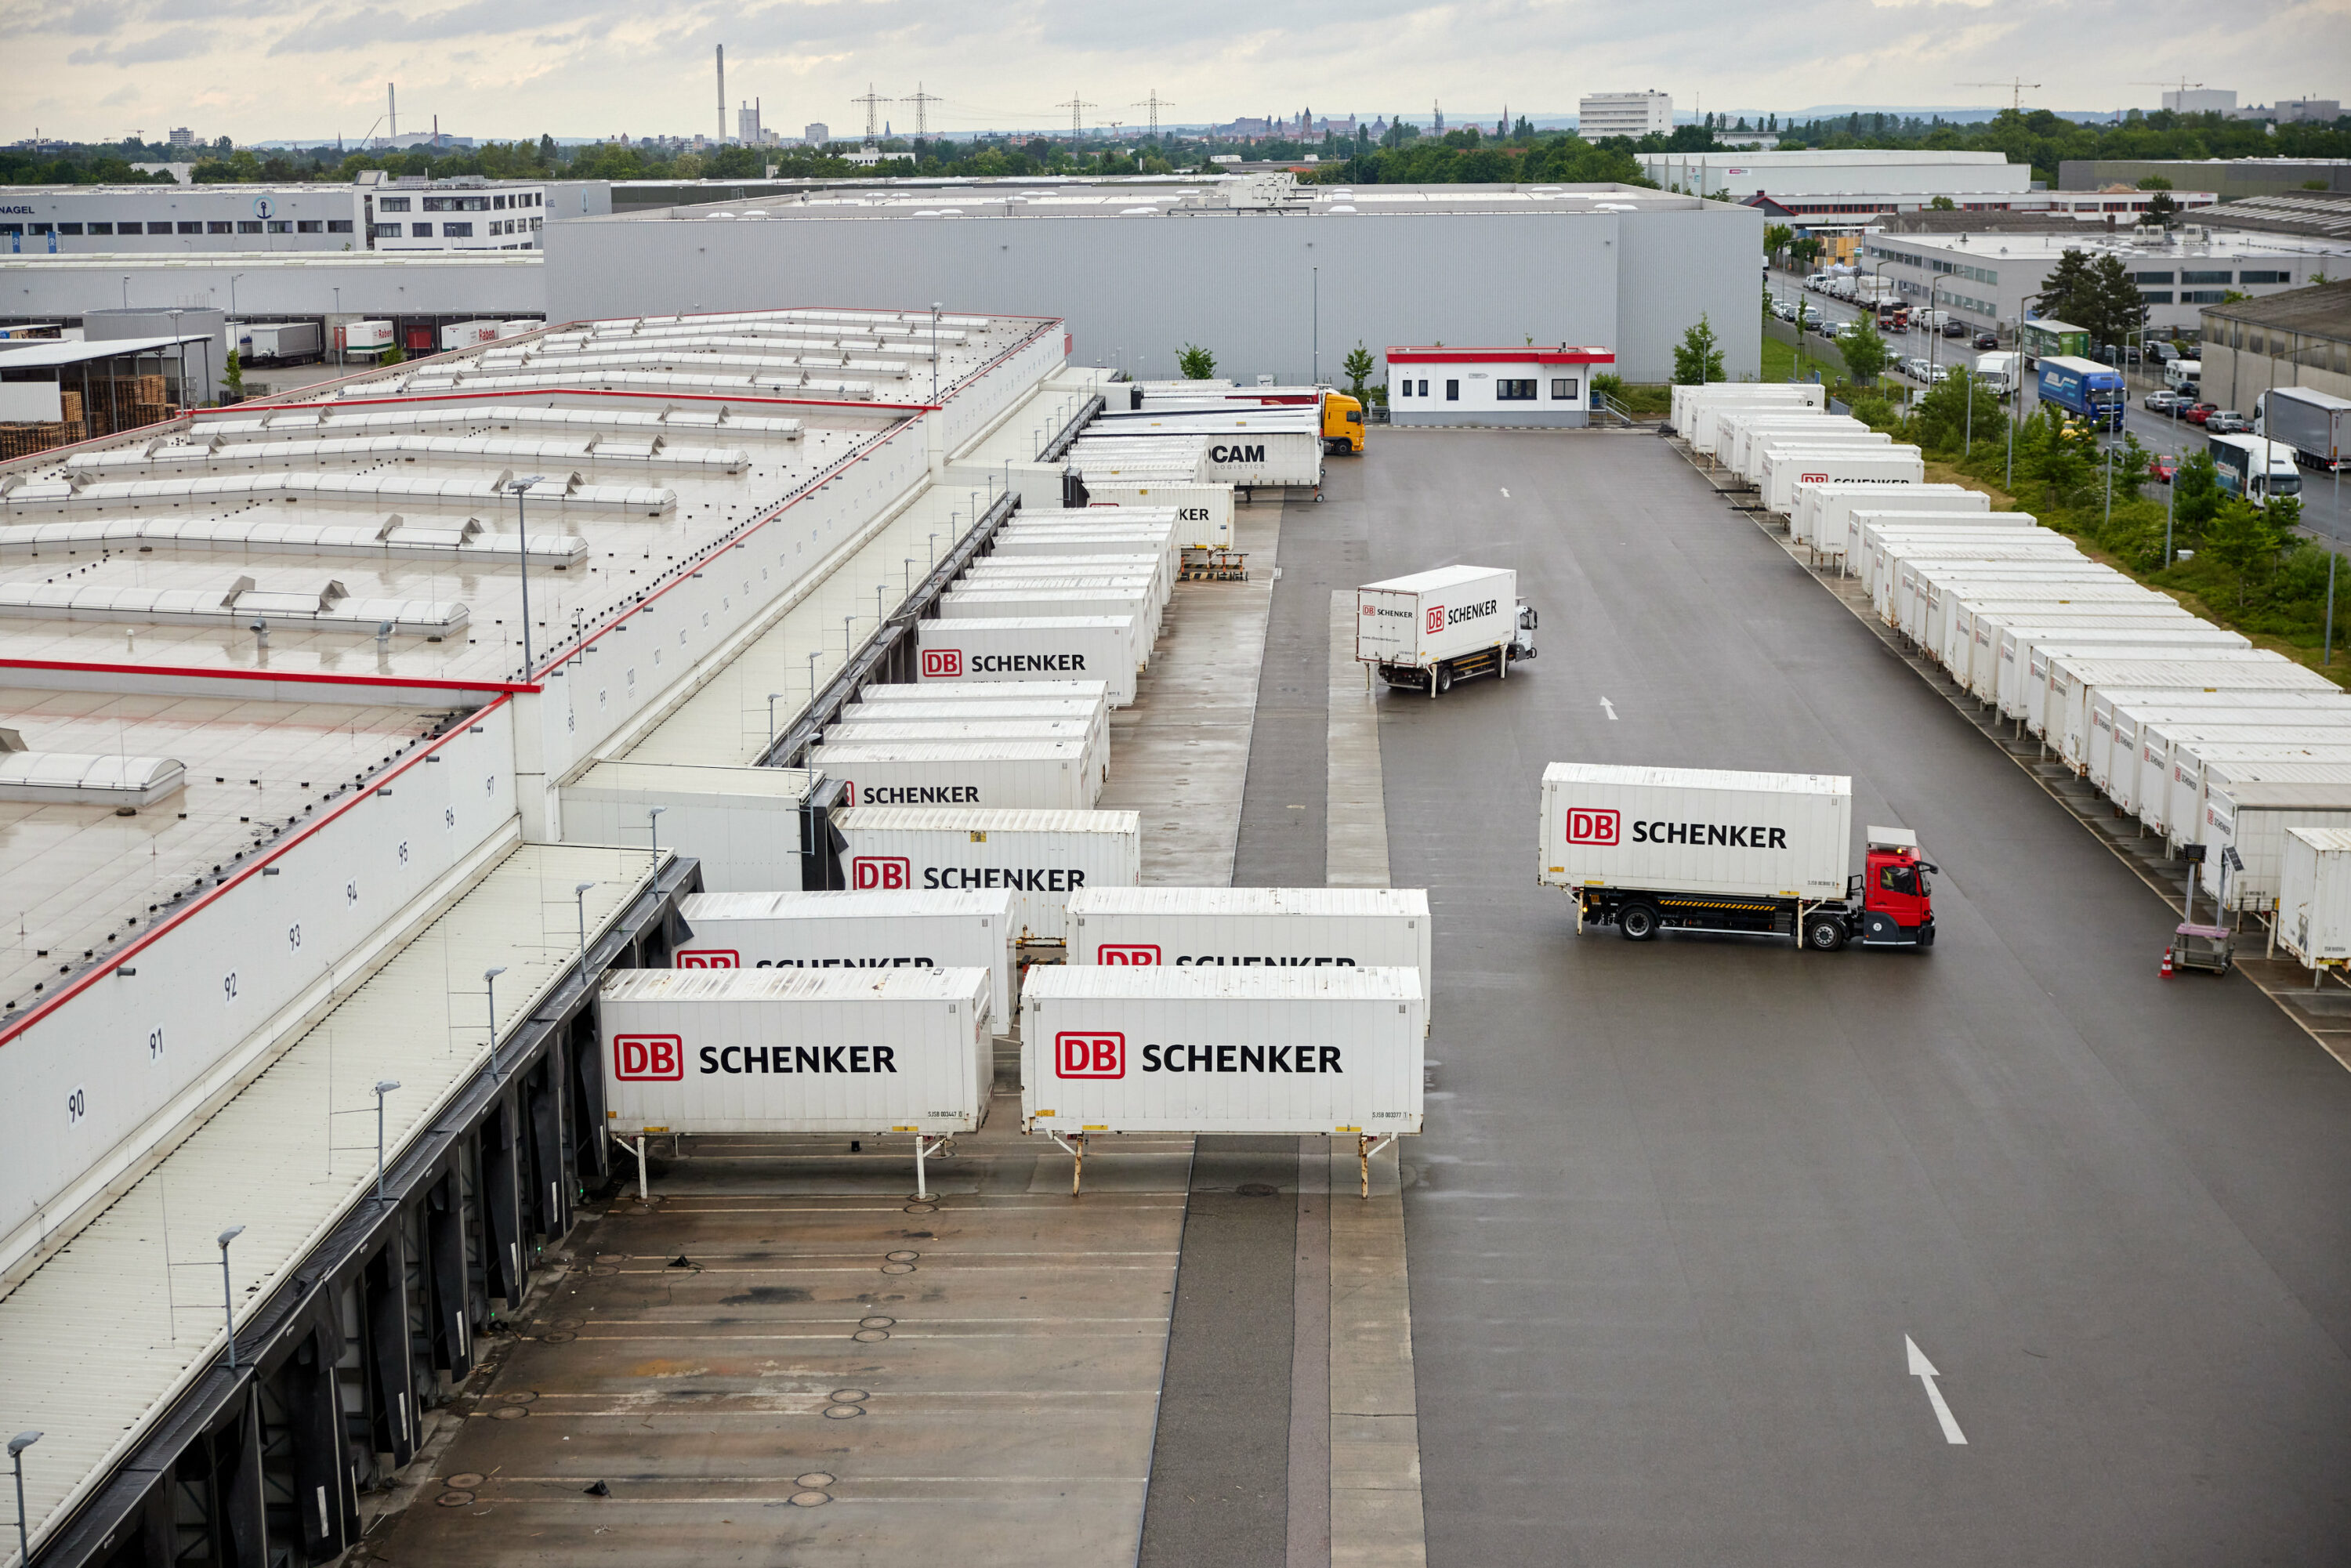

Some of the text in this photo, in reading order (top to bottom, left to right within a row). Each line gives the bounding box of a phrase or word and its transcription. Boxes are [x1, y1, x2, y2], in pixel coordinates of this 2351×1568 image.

[378, 328, 393, 339] Raben
[478, 328, 495, 342] Raben
[1377, 608, 1413, 619] SCHENKER
[1428, 599, 1498, 631] DB SCHENKER
[926, 652, 1086, 674] DB SCHENKER
[600, 690, 606, 709] 99
[568, 714, 575, 734] 98
[487, 775, 494, 798] 97
[864, 786, 980, 805] SCHENKER
[445, 806, 455, 829] 96
[1571, 813, 1788, 849] DB SCHENKER
[398, 841, 408, 866] 95
[857, 862, 1086, 893] DB SCHENKER
[346, 880, 357, 907] 94
[289, 924, 301, 951] 93
[224, 972, 237, 1001] 92
[150, 1027, 163, 1059] 91
[1063, 1038, 1344, 1074] DB SCHENKER
[621, 1041, 897, 1075] DB SCHENKER
[68, 1088, 85, 1123] 90
